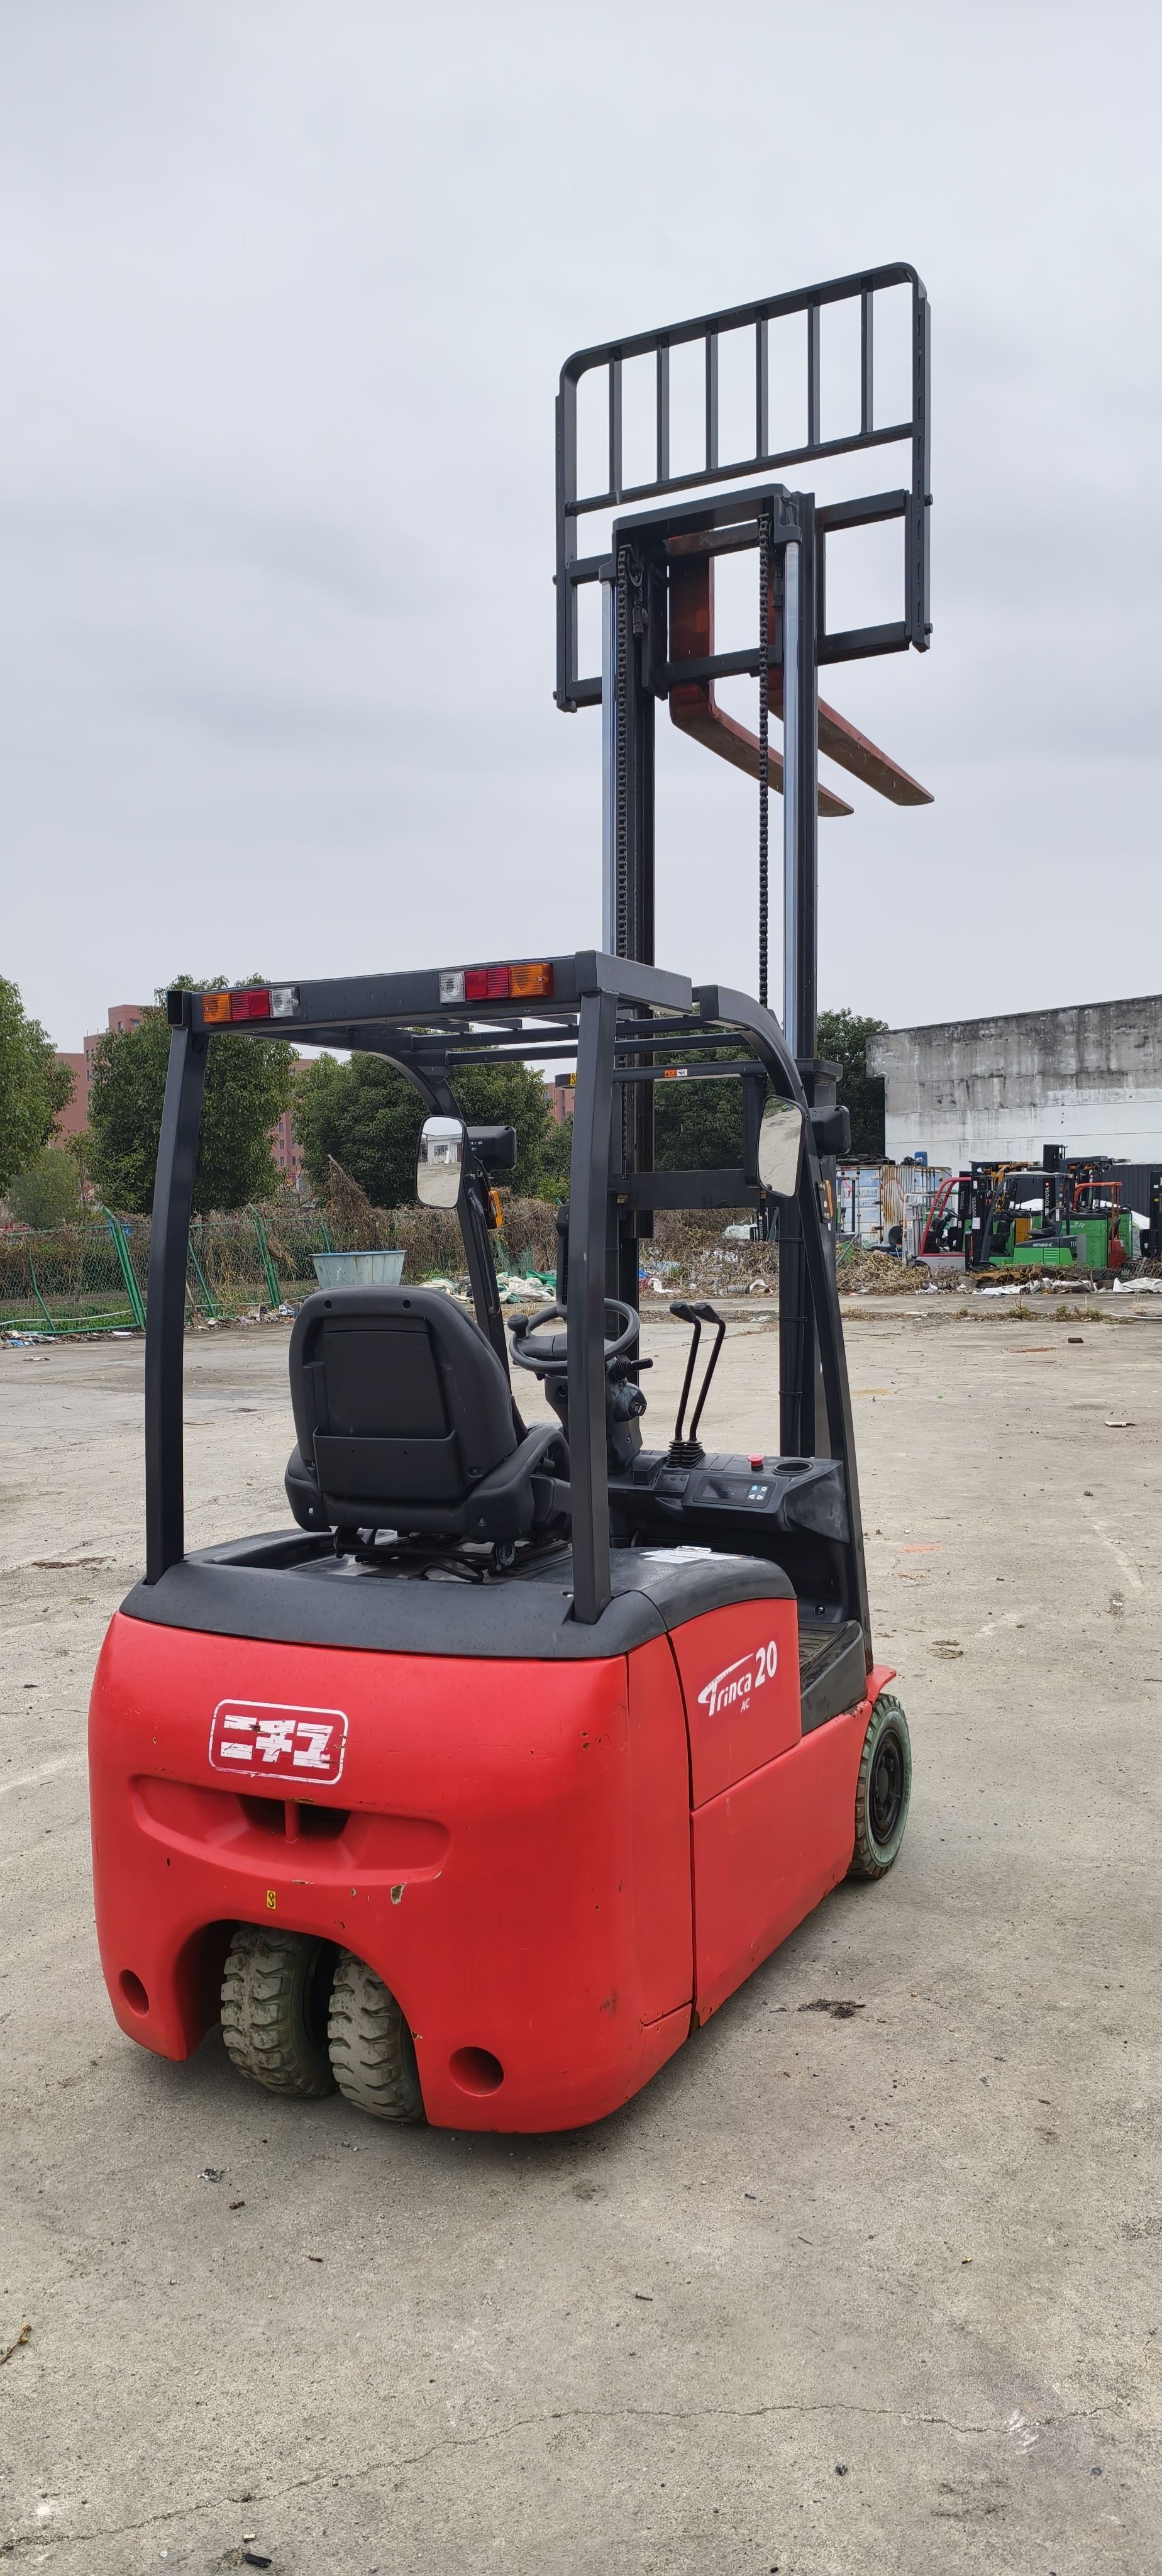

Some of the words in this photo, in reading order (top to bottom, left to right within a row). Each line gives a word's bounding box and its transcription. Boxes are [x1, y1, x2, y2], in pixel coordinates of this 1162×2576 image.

[697, 1653, 754, 1717] Trinca
[755, 1640, 778, 1688] 20
[740, 1697, 750, 1713] AC
